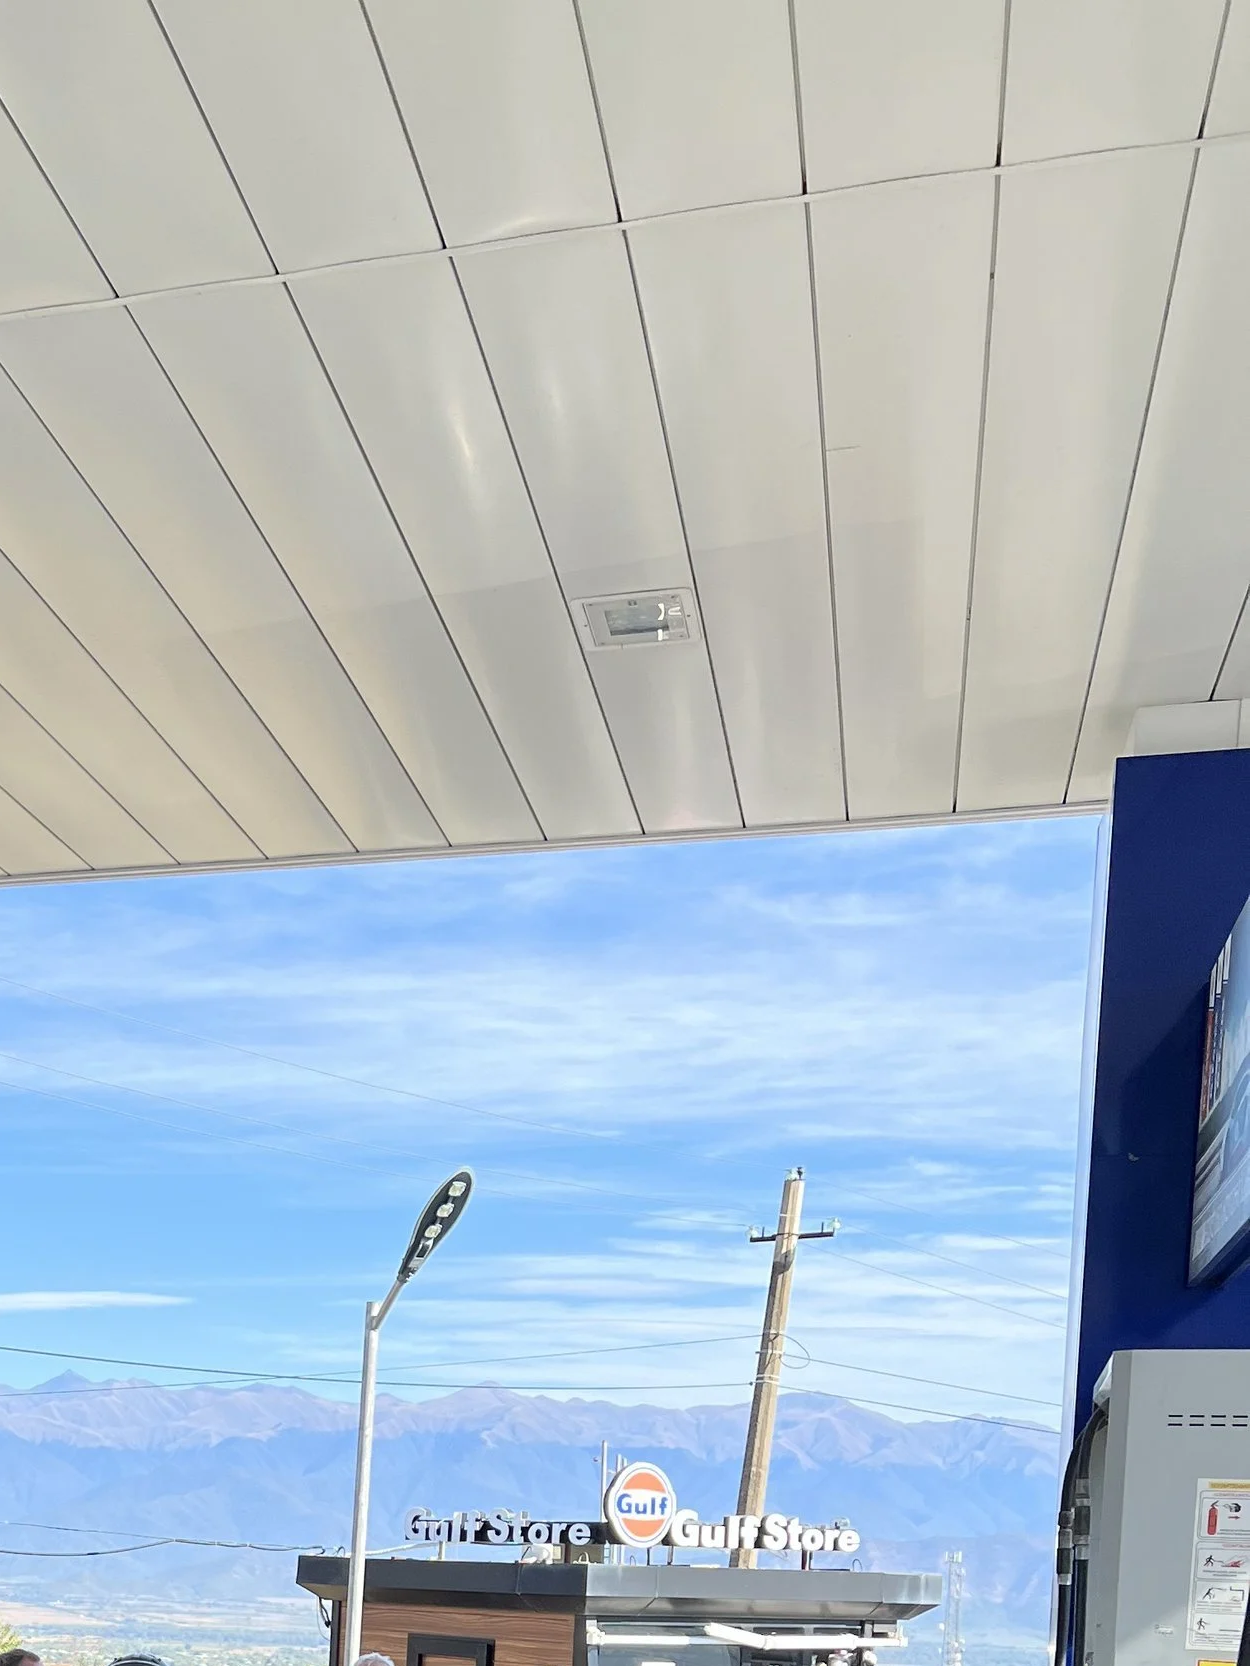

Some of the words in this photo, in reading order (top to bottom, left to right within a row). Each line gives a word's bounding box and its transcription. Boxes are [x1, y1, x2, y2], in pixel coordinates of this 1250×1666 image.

[617, 1493, 669, 1516] Gulf
[405, 1506, 485, 1543] Gulf
[487, 1507, 591, 1546] Store
[671, 1509, 762, 1548] Gulf
[762, 1513, 861, 1553] Store
